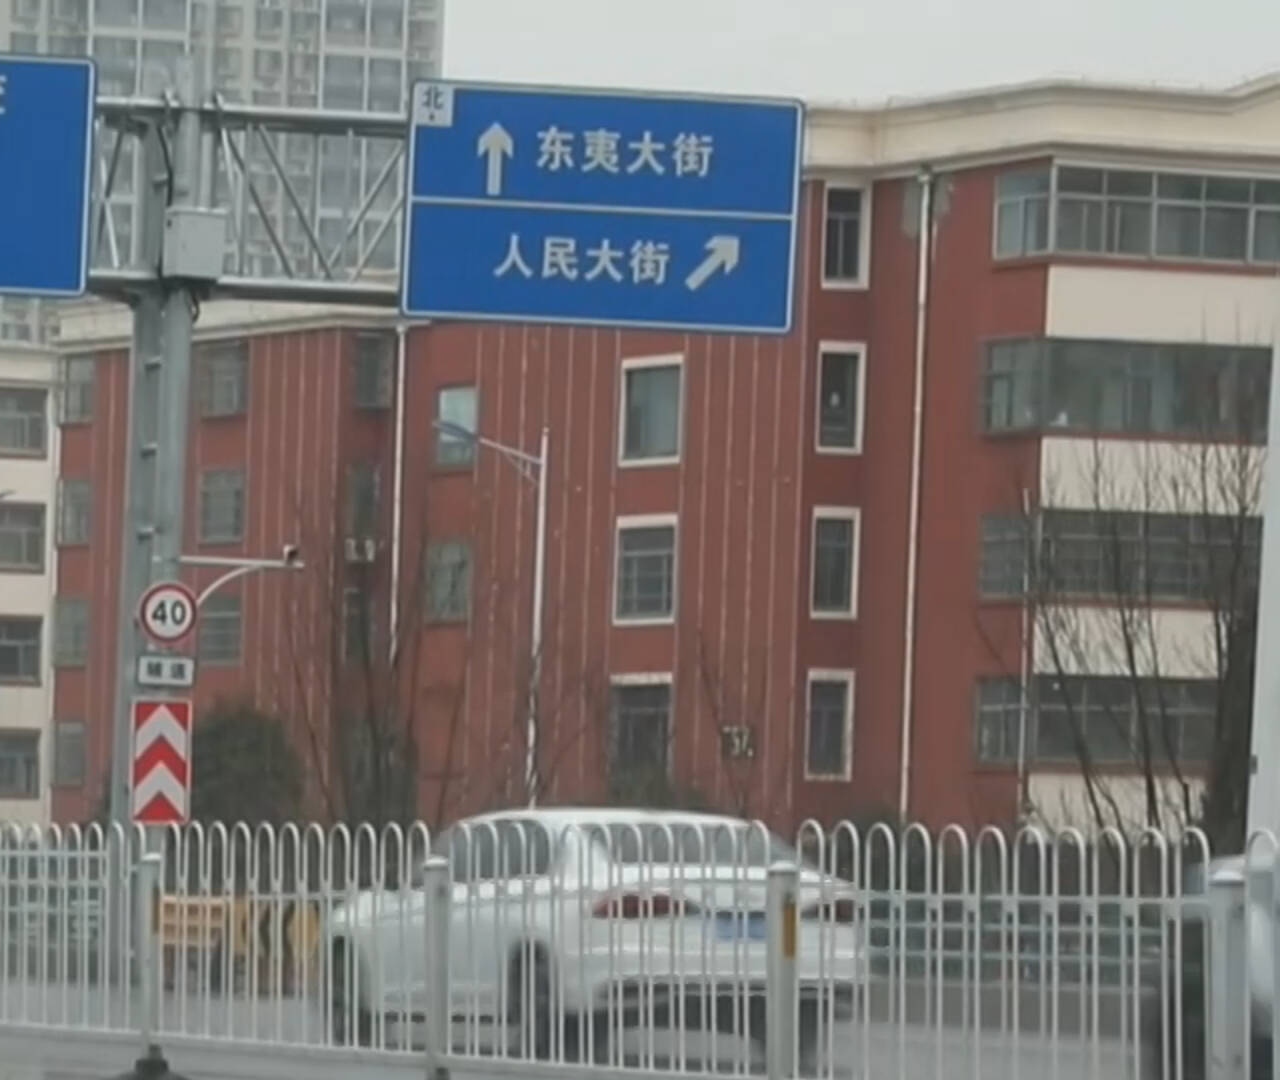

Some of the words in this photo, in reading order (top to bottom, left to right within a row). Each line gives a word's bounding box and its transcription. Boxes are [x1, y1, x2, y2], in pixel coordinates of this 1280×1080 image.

[422, 85, 444, 110] 北
[535, 125, 715, 178] 东夷大街
[492, 232, 671, 286] 人民大街
[151, 600, 187, 626] 40
